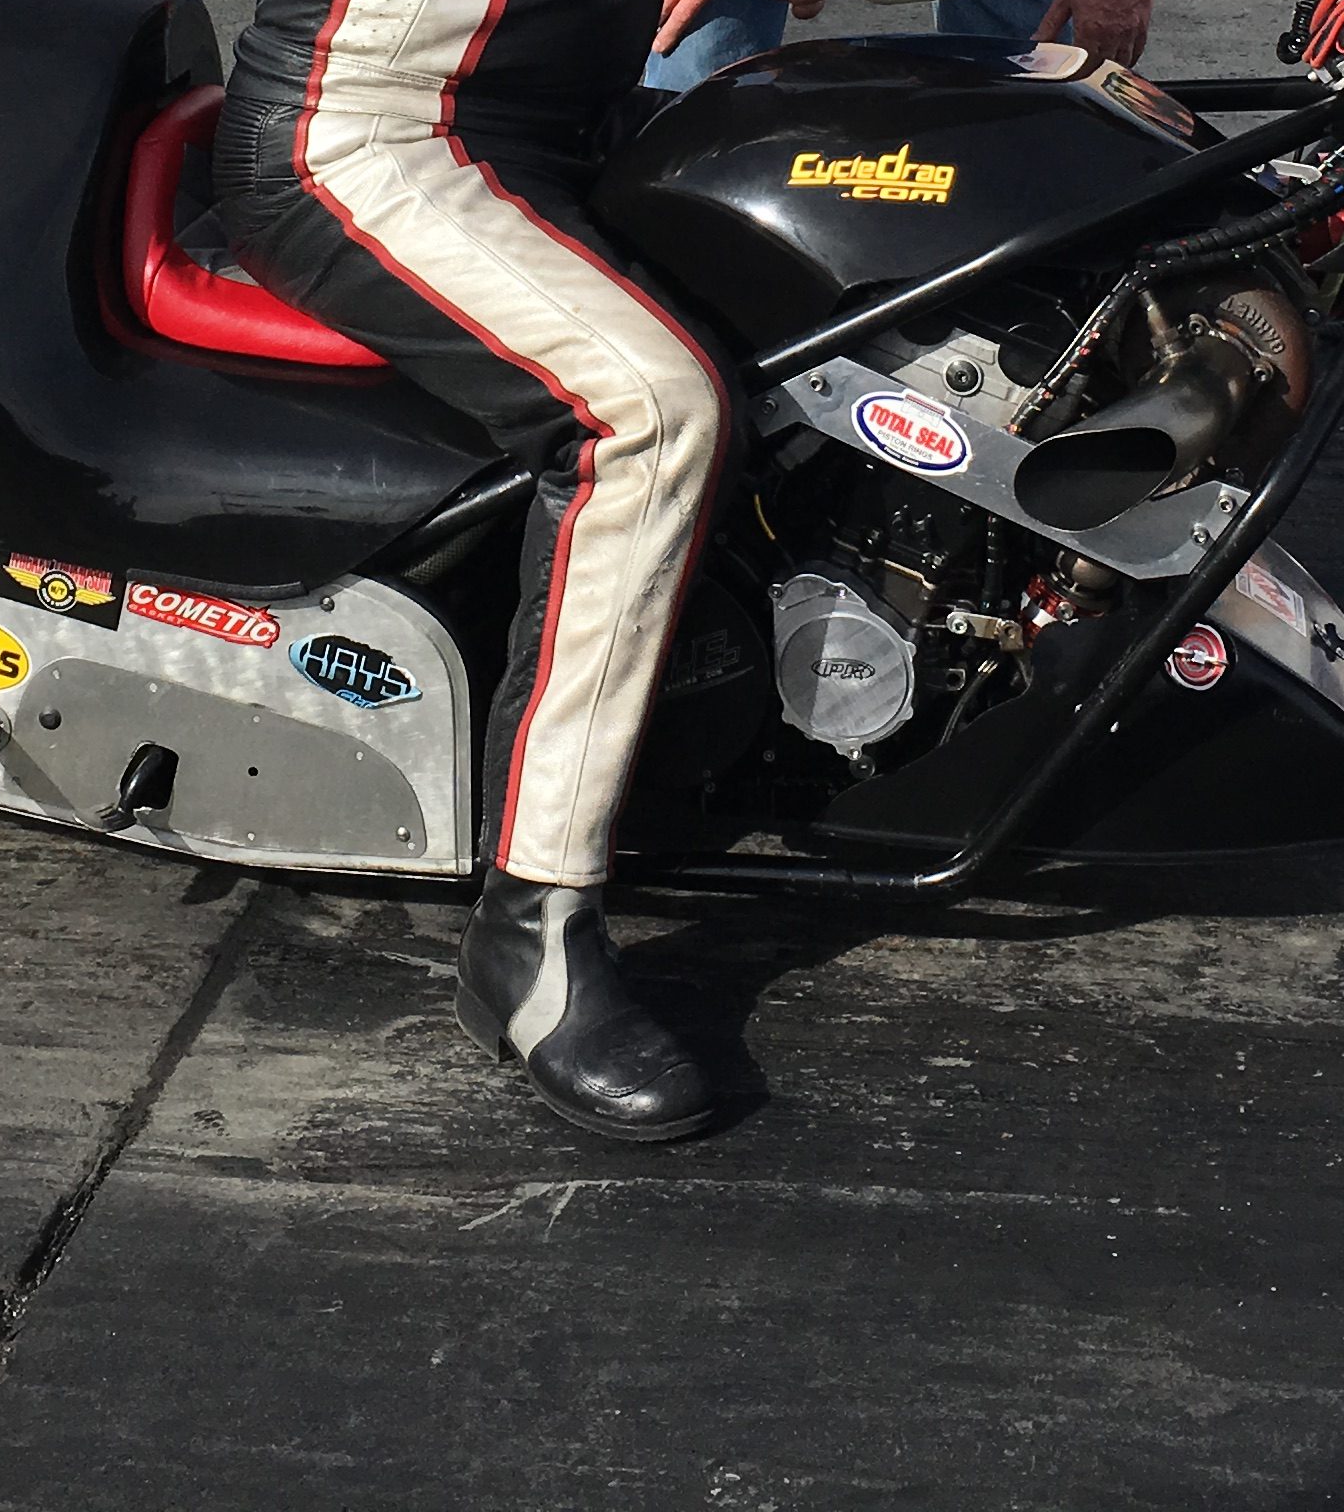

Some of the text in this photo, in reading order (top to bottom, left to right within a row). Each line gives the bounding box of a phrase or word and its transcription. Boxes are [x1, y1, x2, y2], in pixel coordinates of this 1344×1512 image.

[840, 186, 948, 203] .com
[868, 403, 955, 460] TOTAL SEAL
[877, 429, 907, 448] PISTON
[908, 444, 934, 461] RINGS
[131, 585, 277, 642] COMETIC
[303, 642, 408, 698] HAYS
